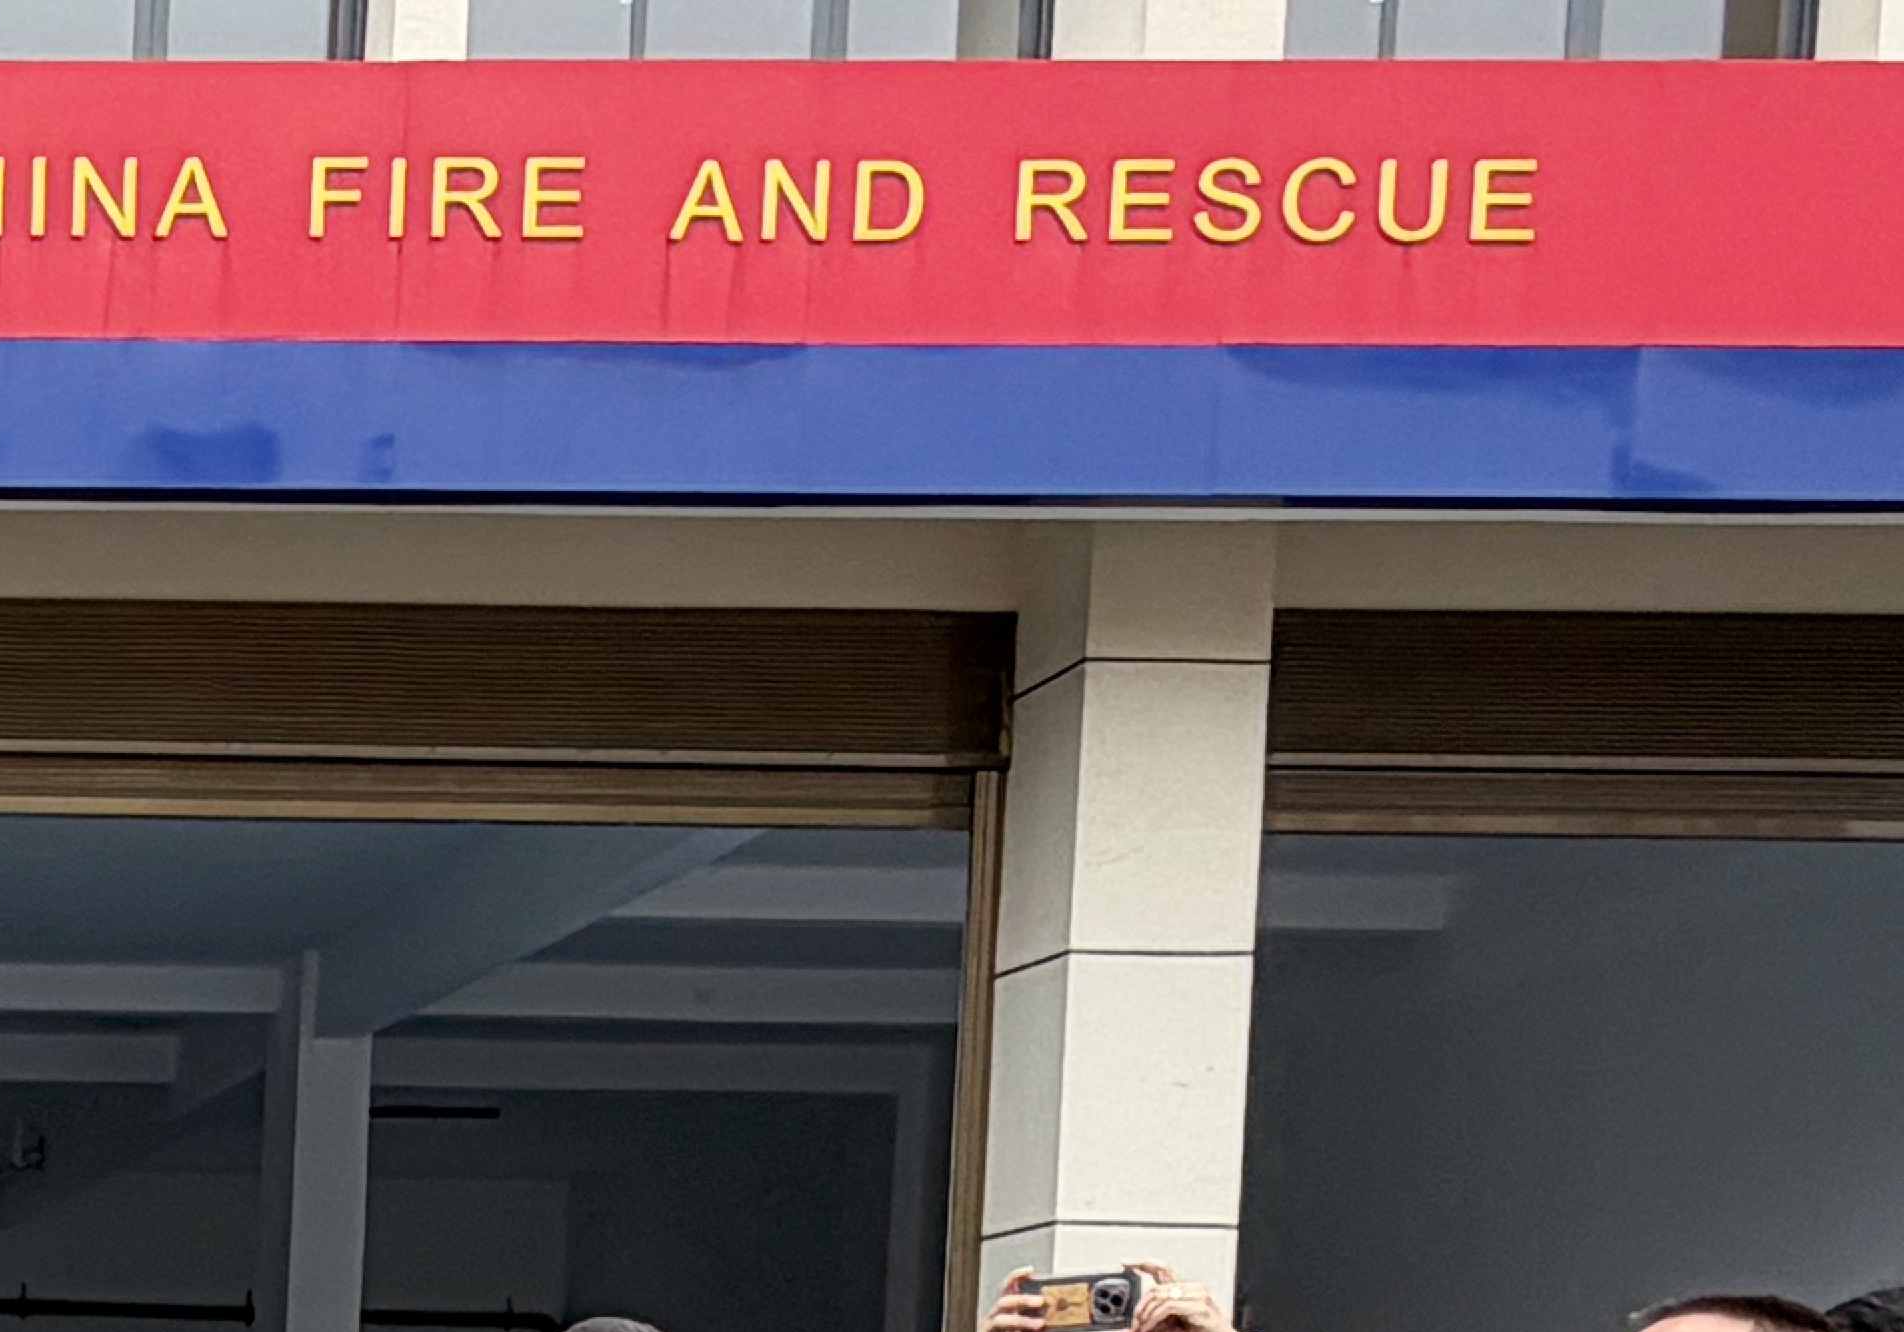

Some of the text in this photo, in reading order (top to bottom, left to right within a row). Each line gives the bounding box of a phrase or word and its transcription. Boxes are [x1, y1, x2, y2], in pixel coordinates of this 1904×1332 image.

[309, 156, 586, 239] FIRE
[671, 160, 927, 244] AND
[1014, 158, 1538, 244] RESCUE
